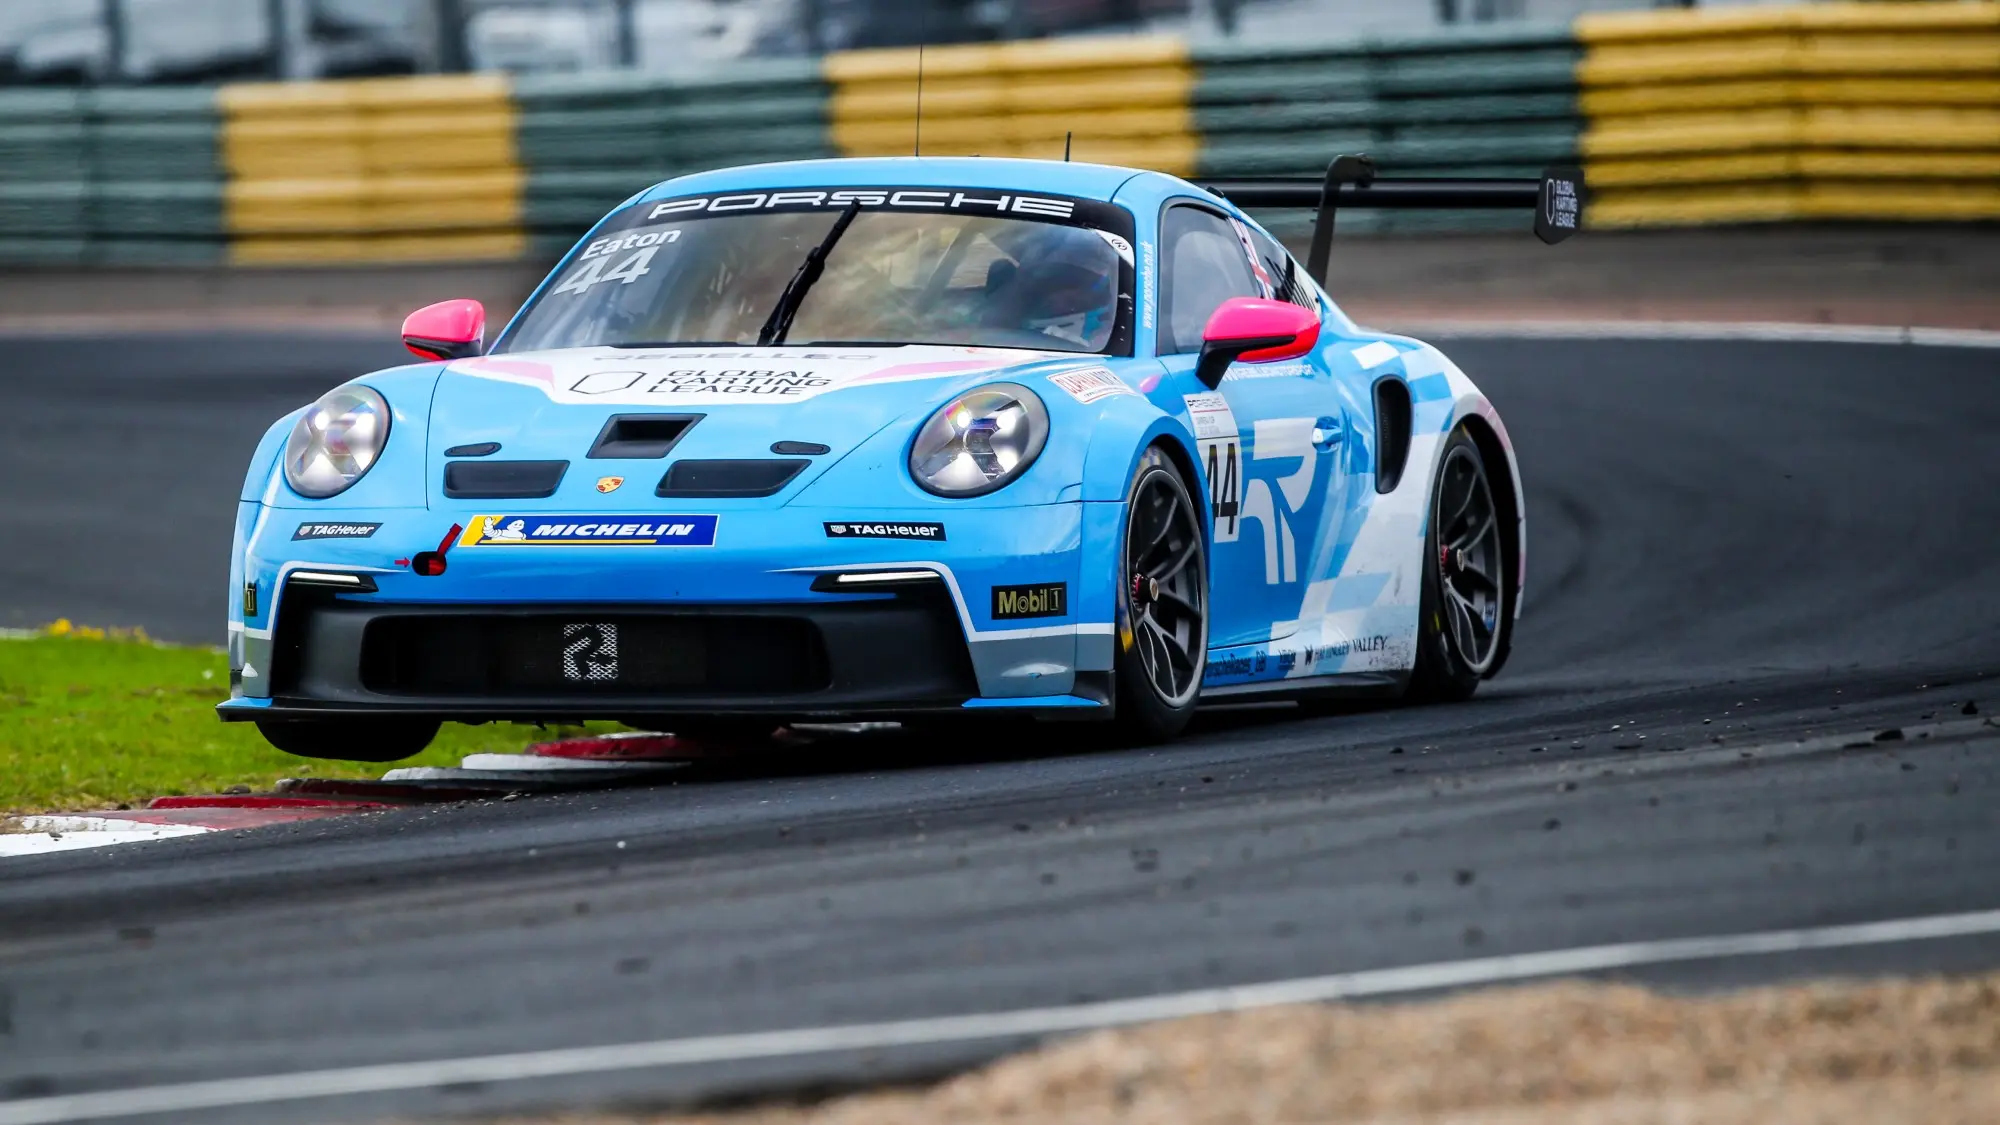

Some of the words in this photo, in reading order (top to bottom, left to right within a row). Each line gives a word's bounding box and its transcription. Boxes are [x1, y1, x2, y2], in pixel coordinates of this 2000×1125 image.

[1556, 180, 1576, 197] GLOBAL
[648, 190, 1075, 220] PORSCHE
[1556, 211, 1576, 228] LEAGUE
[579, 228, 682, 261] Eaton
[553, 245, 653, 298] 44
[657, 377, 832, 388] KARTING
[667, 369, 818, 379] GLOBAL
[647, 385, 804, 395] LEAGUE
[1207, 442, 1239, 535] 44
[531, 522, 695, 537] MICHELIN
[1352, 635, 1388, 653] VALLEY
